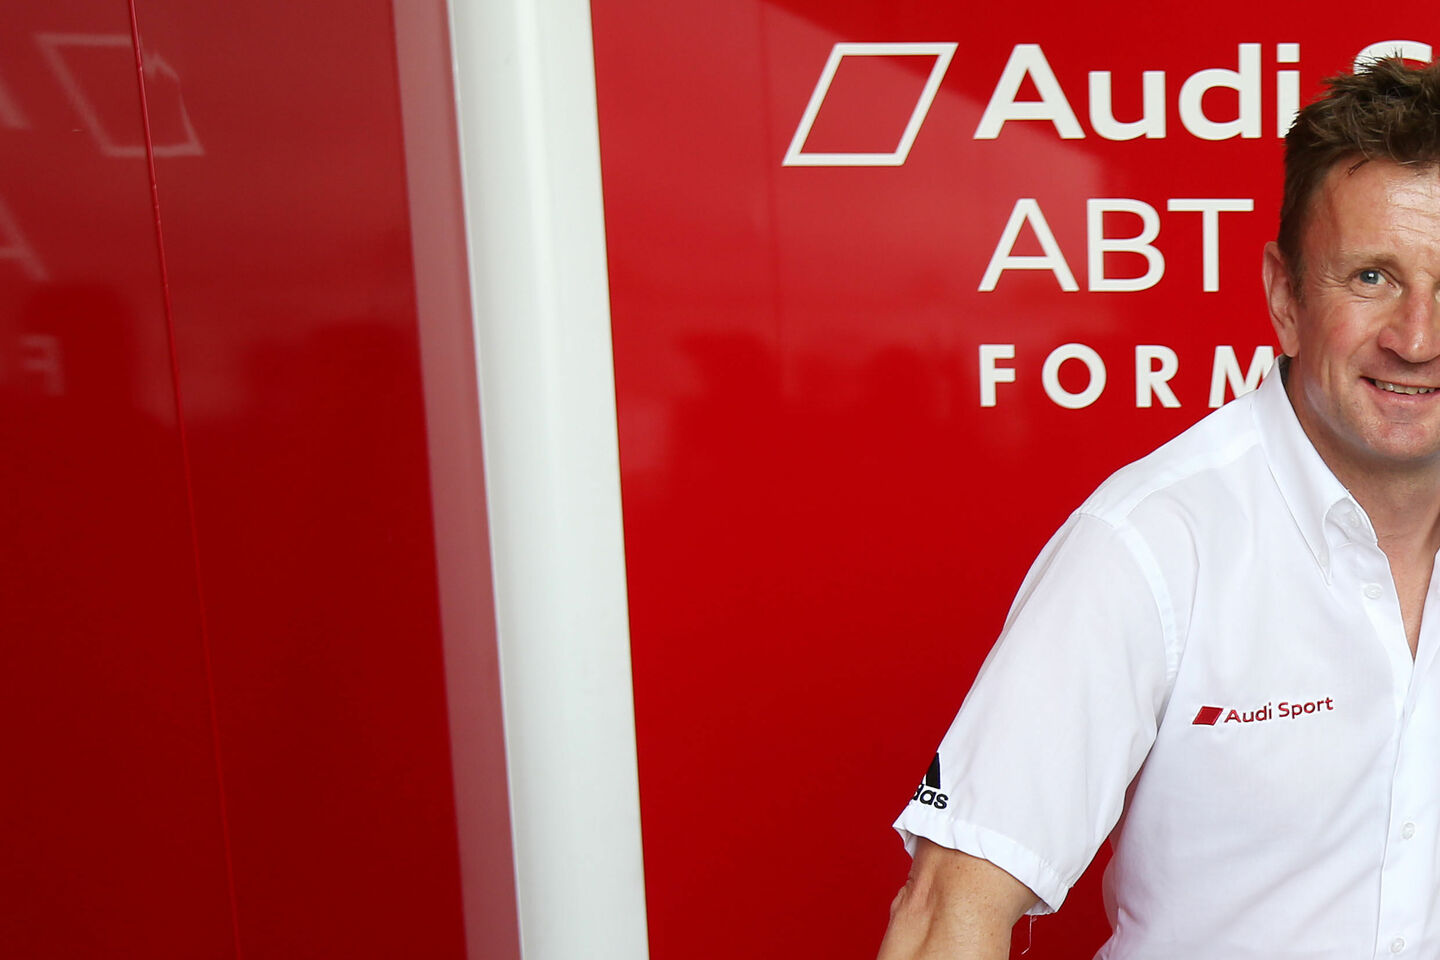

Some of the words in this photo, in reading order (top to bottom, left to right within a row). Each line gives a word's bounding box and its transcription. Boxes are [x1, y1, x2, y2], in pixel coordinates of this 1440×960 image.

[973, 42, 1300, 140] Audi
[977, 198, 1254, 292] ABT
[1223, 702, 1273, 724] Audi
[1277, 697, 1334, 719] Sport
